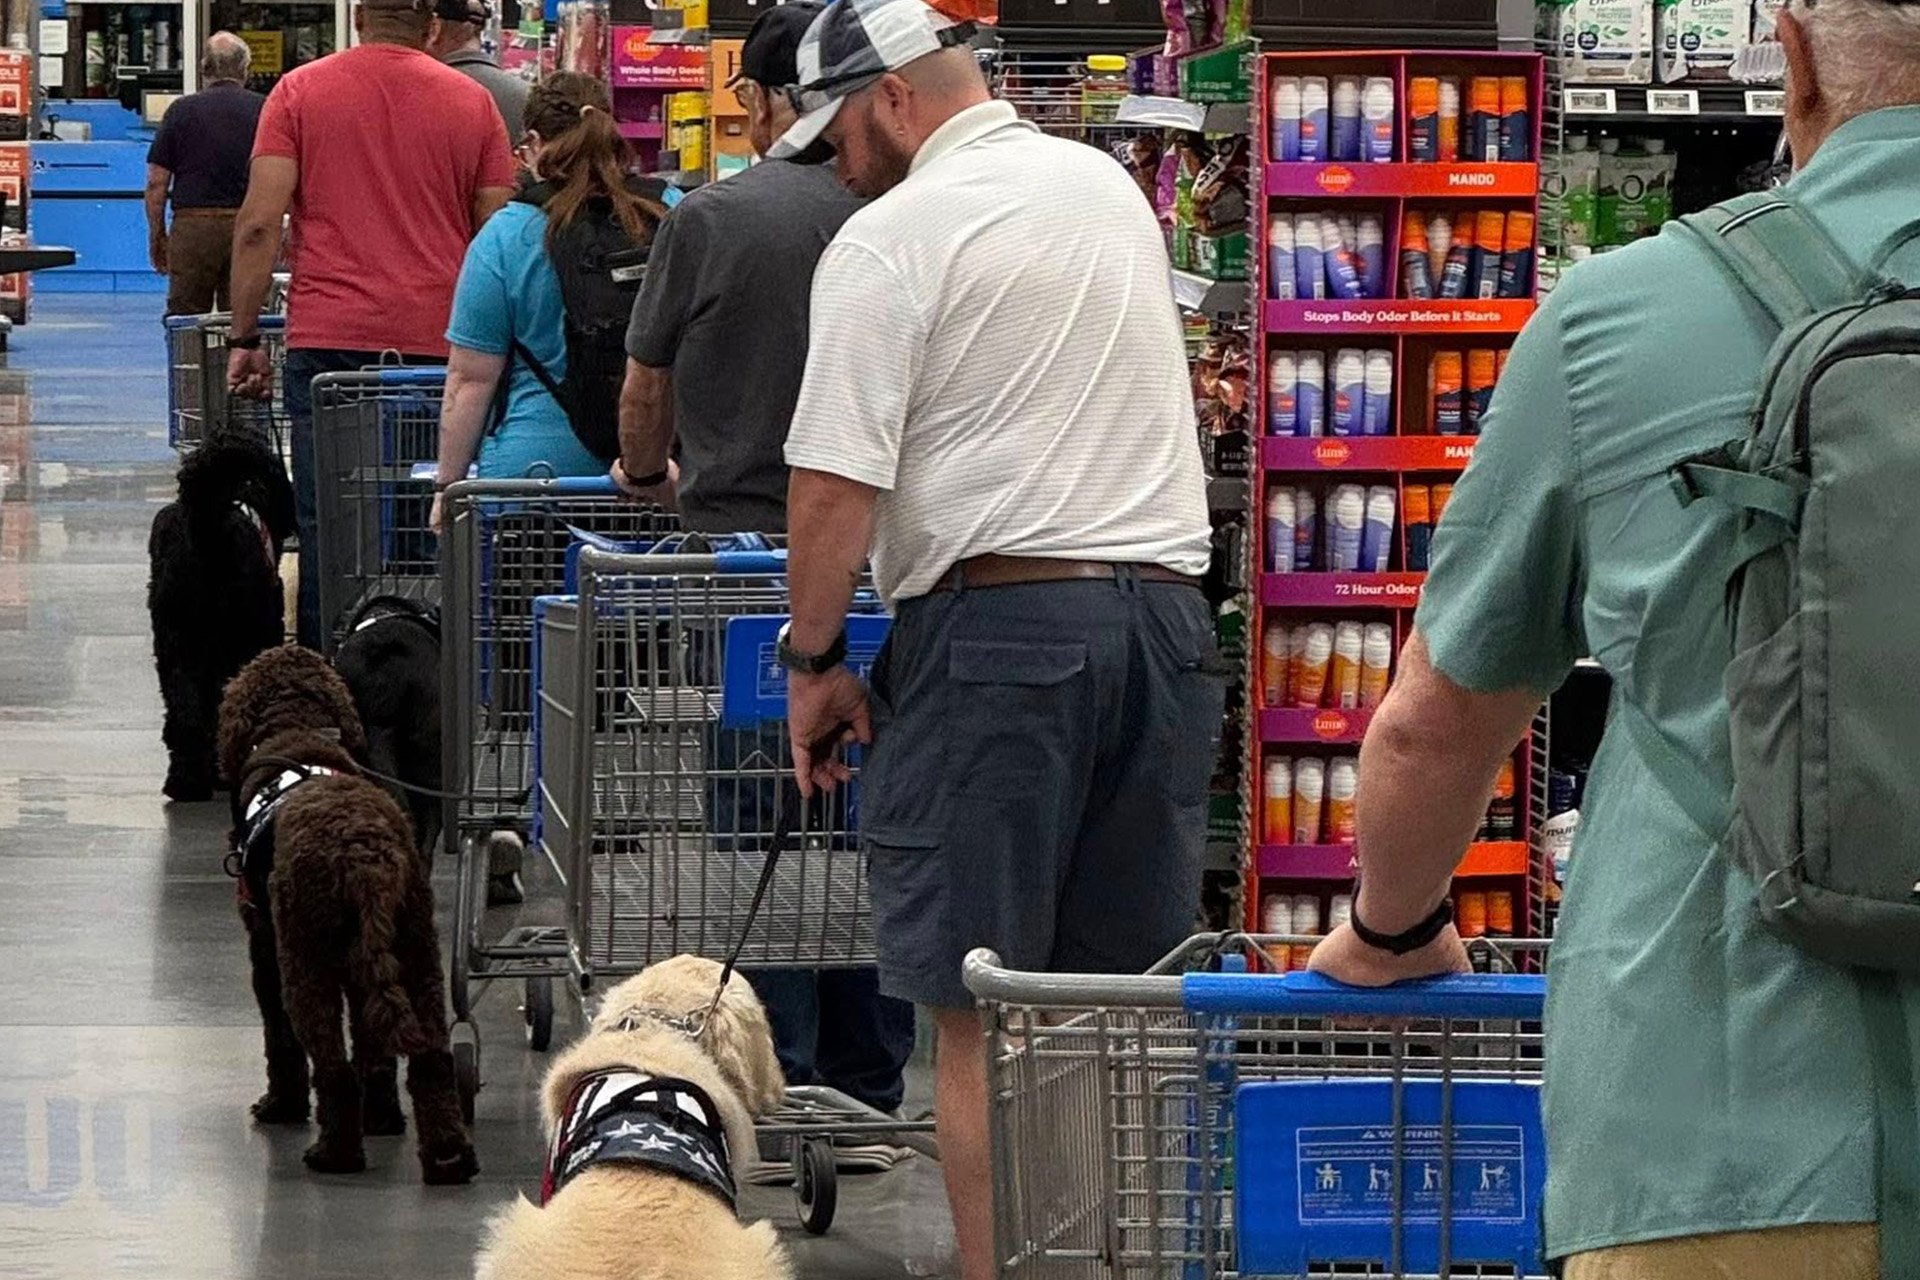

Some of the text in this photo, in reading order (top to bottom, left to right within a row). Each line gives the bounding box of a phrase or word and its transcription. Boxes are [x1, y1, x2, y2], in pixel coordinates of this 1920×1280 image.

[652, 66, 677, 77] Body
[1449, 173, 1495, 186] MANDO
[1304, 311, 1339, 323] Stops
[1342, 311, 1374, 323] Body
[1376, 311, 1408, 322] Odor
[1410, 311, 1450, 321] Before
[1463, 311, 1501, 321] Starts
[1445, 446, 1474, 458] MAN
[1335, 584, 1350, 595] 72
[1352, 584, 1384, 595] Hour
[1386, 583, 1417, 595] Odor
[1379, 1130, 1459, 1138] WRNIN
